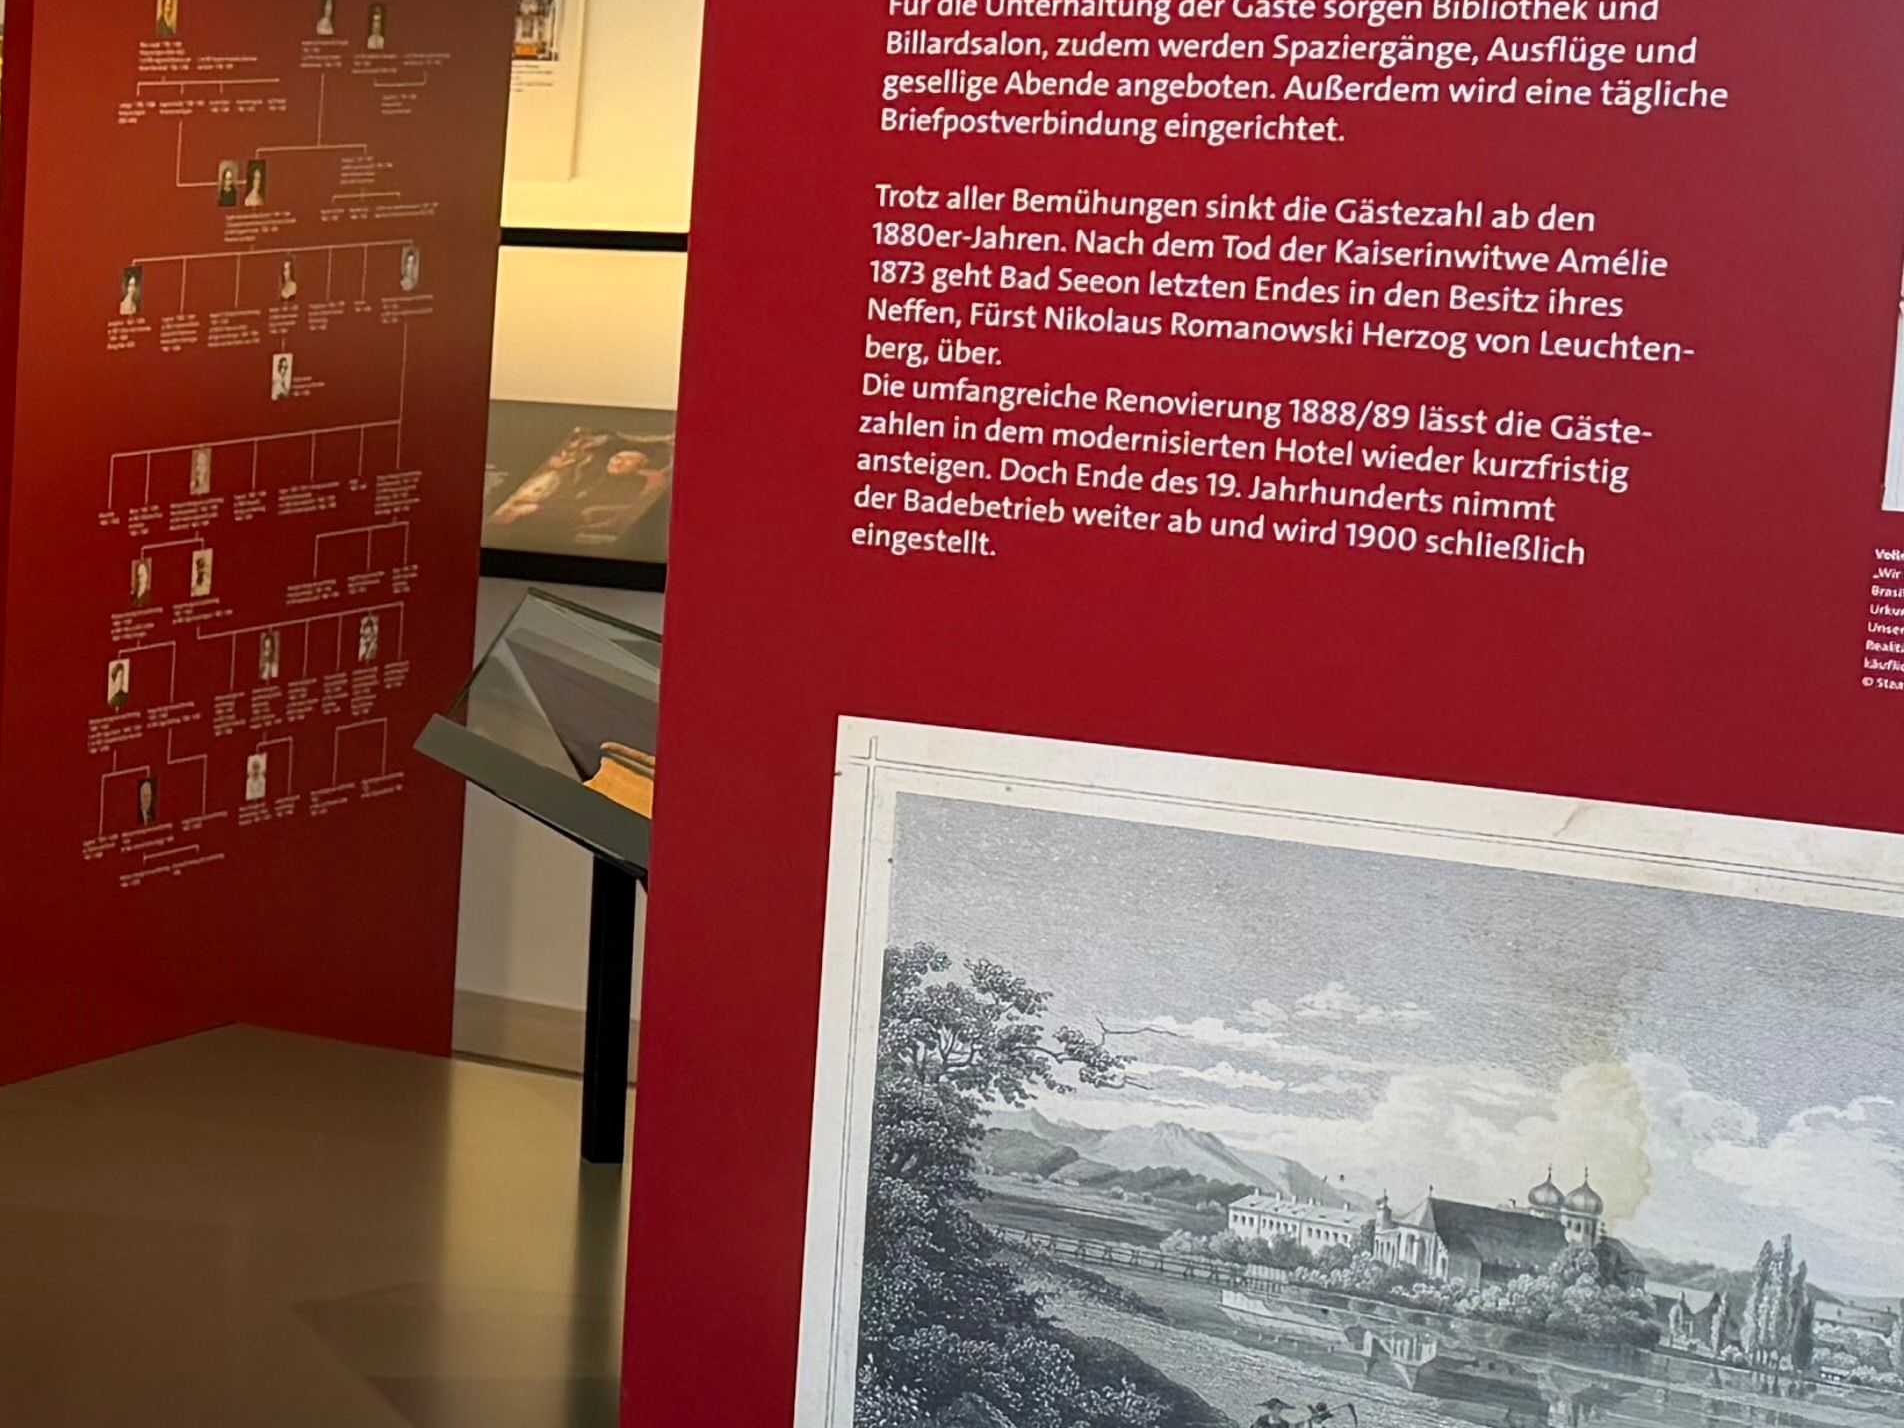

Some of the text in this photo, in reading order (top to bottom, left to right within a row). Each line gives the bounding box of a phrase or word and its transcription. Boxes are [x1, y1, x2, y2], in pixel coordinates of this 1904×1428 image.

[881, 107, 1344, 146] Briefpostverbindung eingerichtet.
[863, 373, 1652, 444] Die umfangreiche Renovierung 1888/89 lässt die Gäste-
[852, 523, 995, 555] eingestellt.
